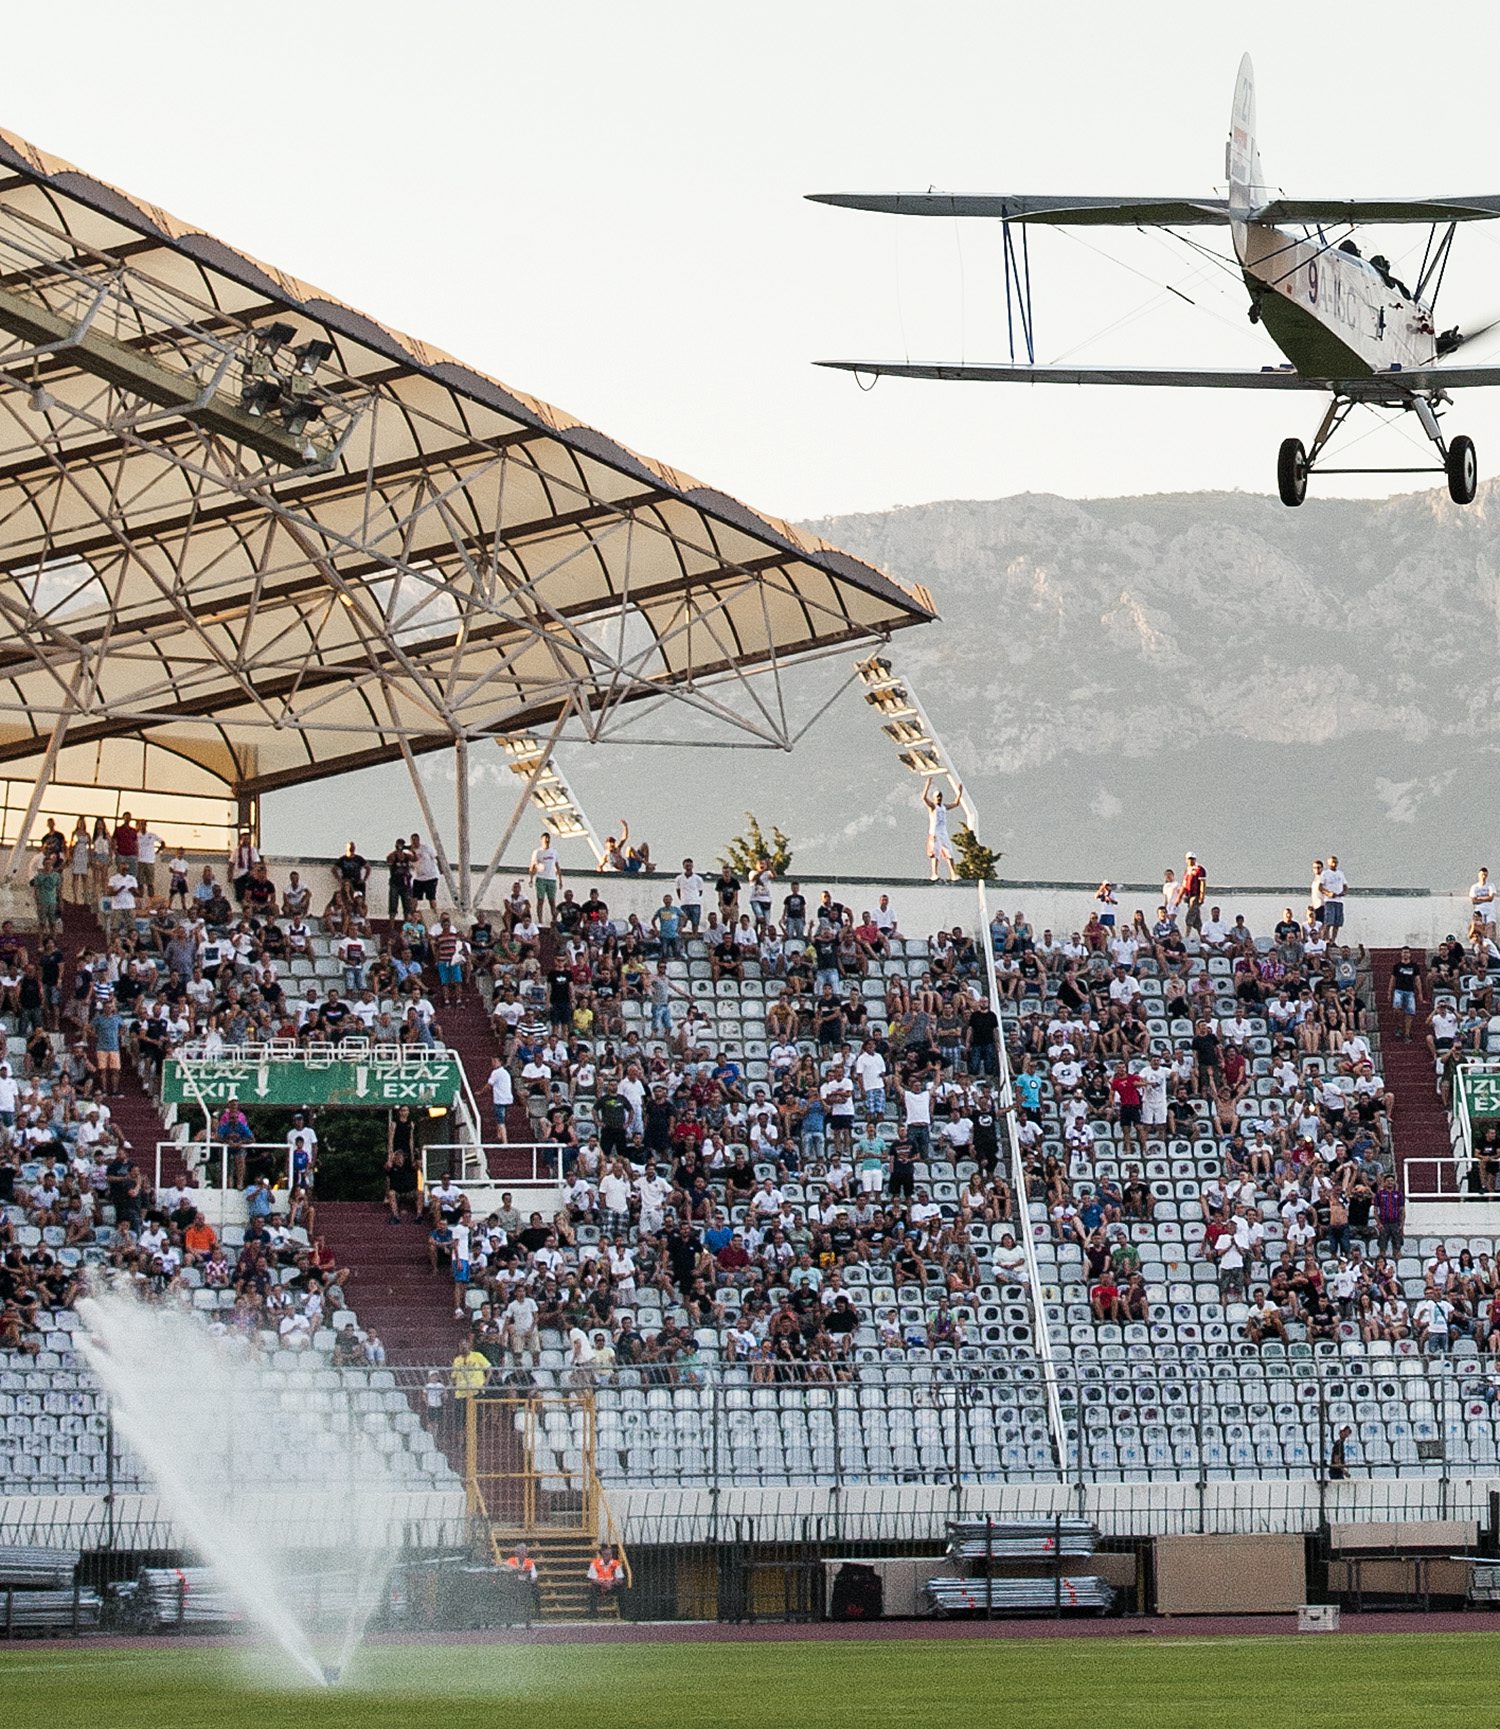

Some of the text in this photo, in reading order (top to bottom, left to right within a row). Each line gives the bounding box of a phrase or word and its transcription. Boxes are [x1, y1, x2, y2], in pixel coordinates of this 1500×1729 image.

[376, 1065, 449, 1080] IZLAZ
[182, 1082, 240, 1098] EXIT
[383, 1083, 440, 1098] EXIT
